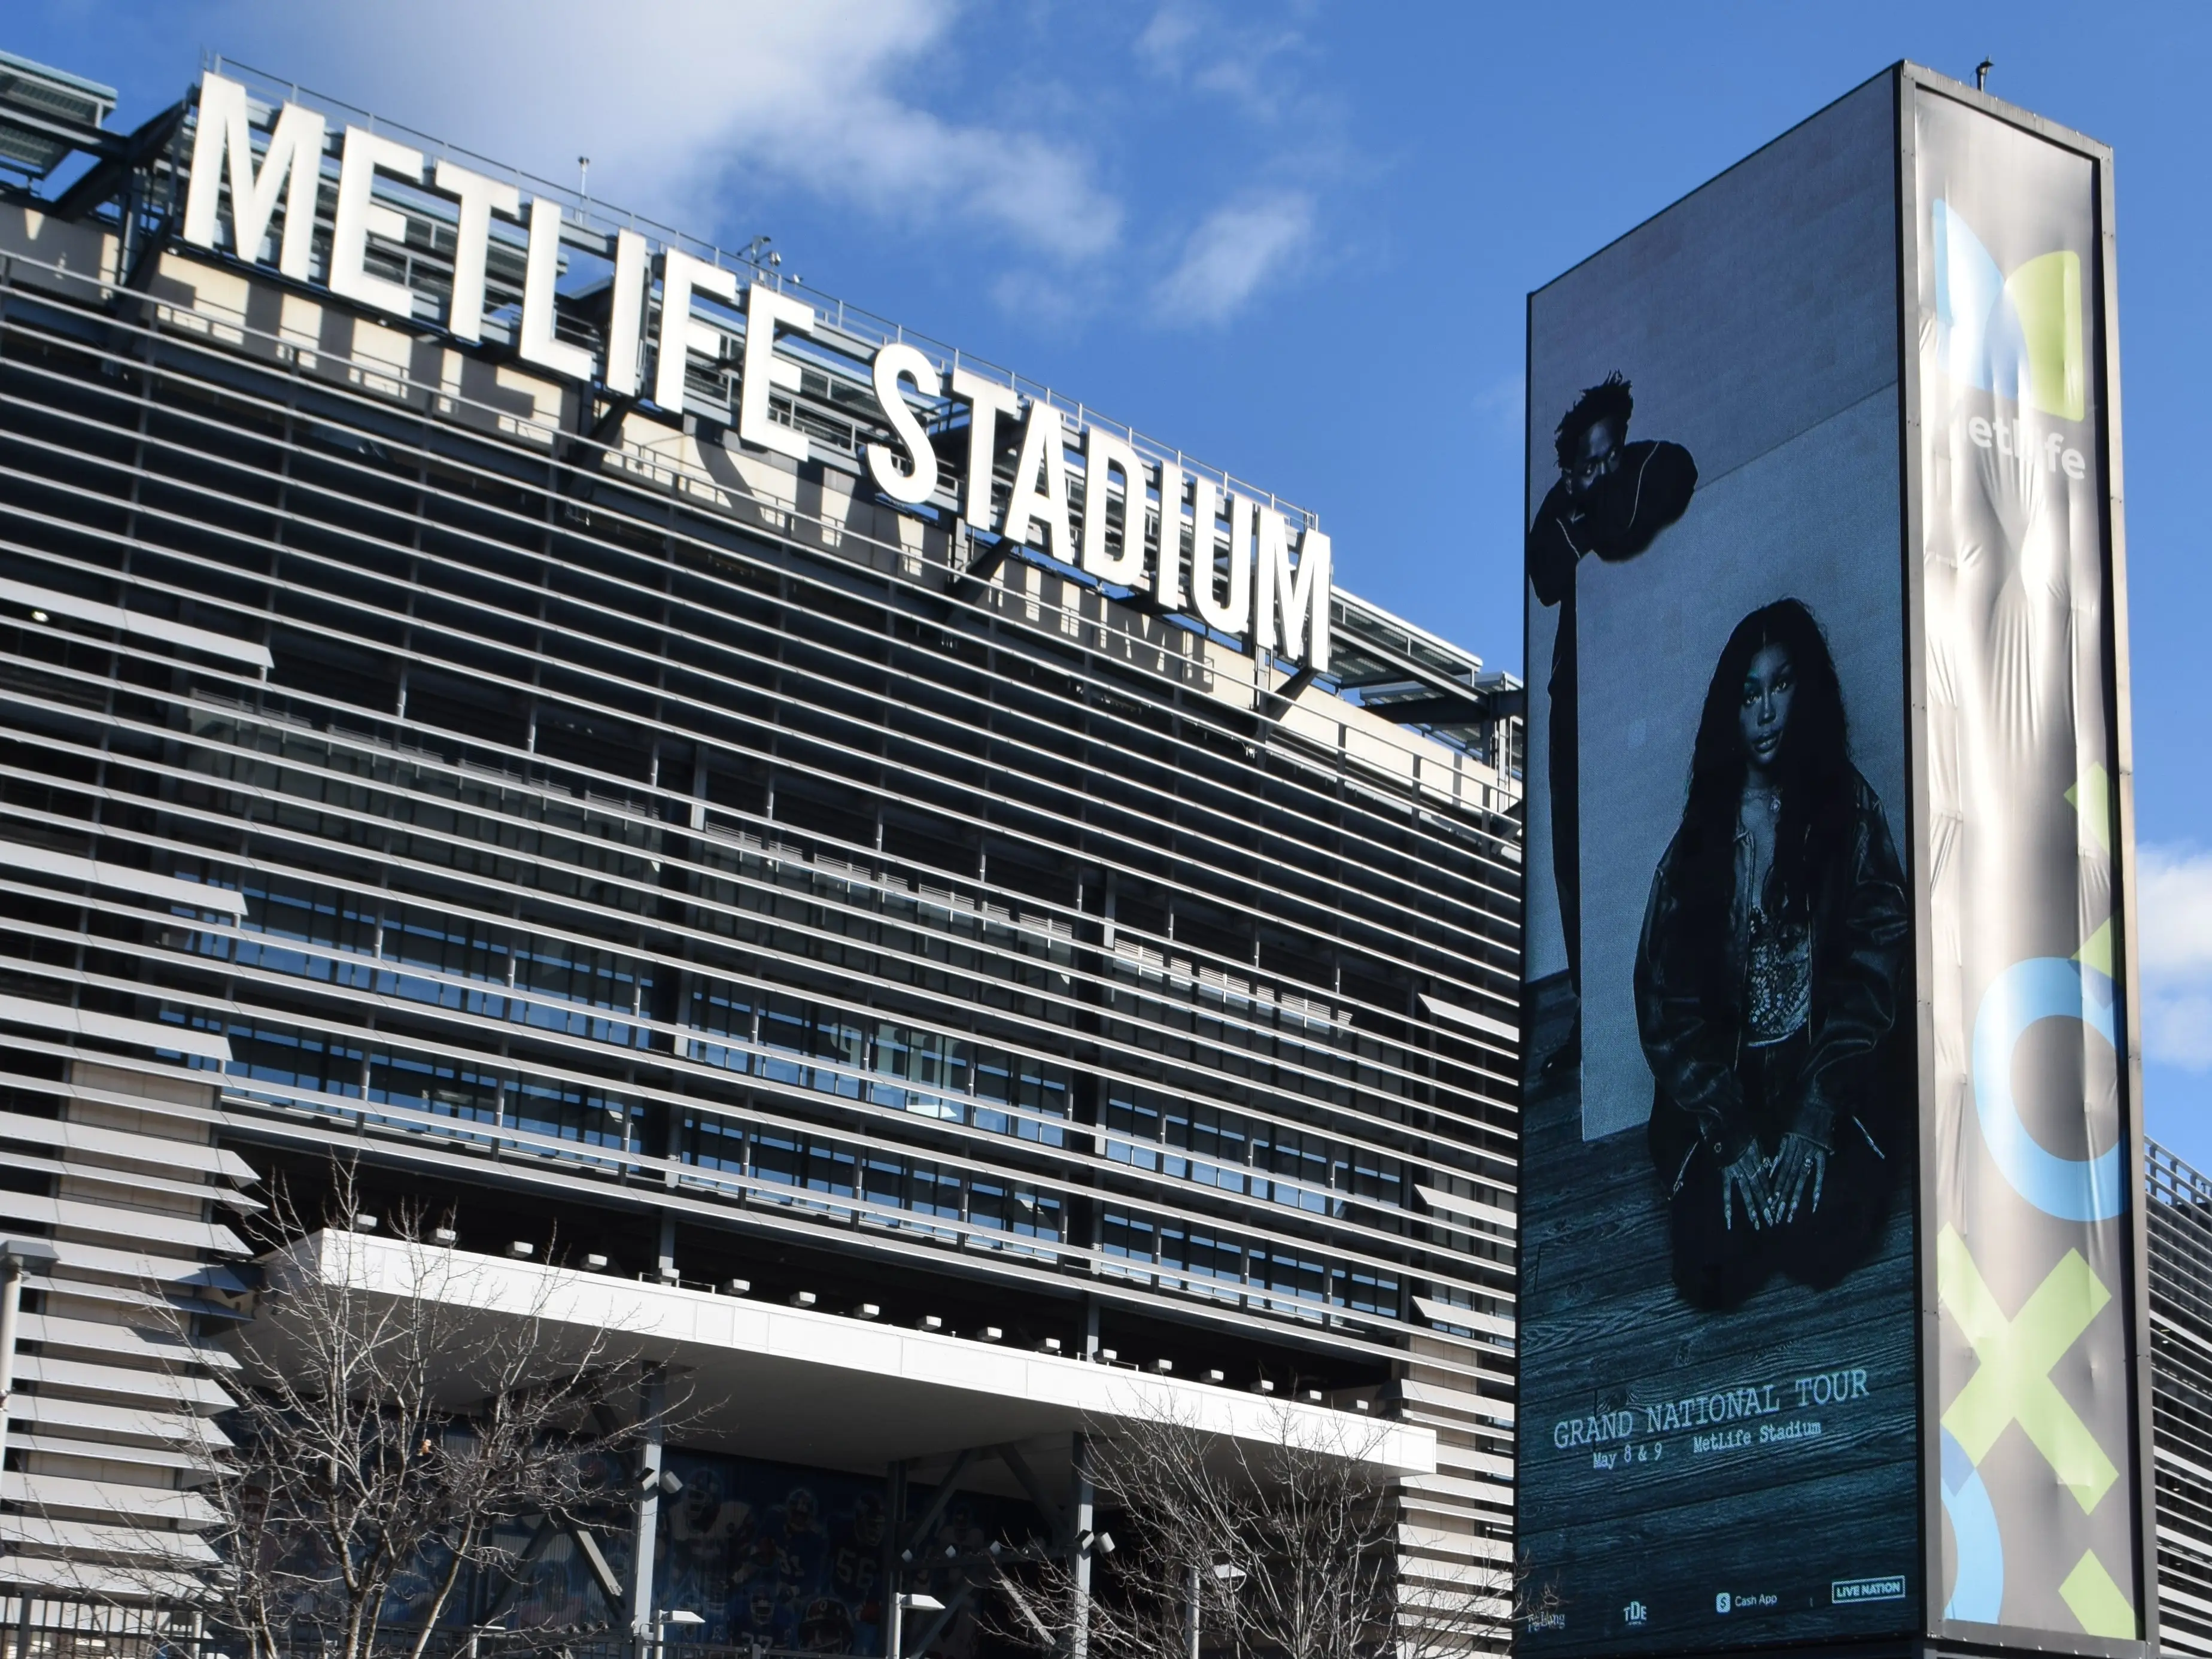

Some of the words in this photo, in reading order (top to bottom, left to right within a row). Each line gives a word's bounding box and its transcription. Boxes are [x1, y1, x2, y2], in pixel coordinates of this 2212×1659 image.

[183, 71, 815, 461] METLIFE
[865, 344, 1330, 672] STADIUM
[1554, 1411, 1633, 1449] GRAND
[1646, 1384, 1780, 1433] NATIONAL
[1795, 1368, 1870, 1406] TOUR
[1593, 1451, 1617, 1470] May
[1624, 1444, 1631, 1463] 8
[1638, 1444, 1647, 1462] &
[1654, 1442, 1663, 1461] 9
[1693, 1429, 1751, 1453] MetLife
[1760, 1421, 1821, 1444] Stadium
[1735, 1595, 1757, 1607] Cash
[1758, 1593, 1778, 1607] App
[1836, 1584, 1860, 1597] LIVE
[1861, 1581, 1901, 1596] NATION
[1623, 1601, 1646, 1622] TDE
